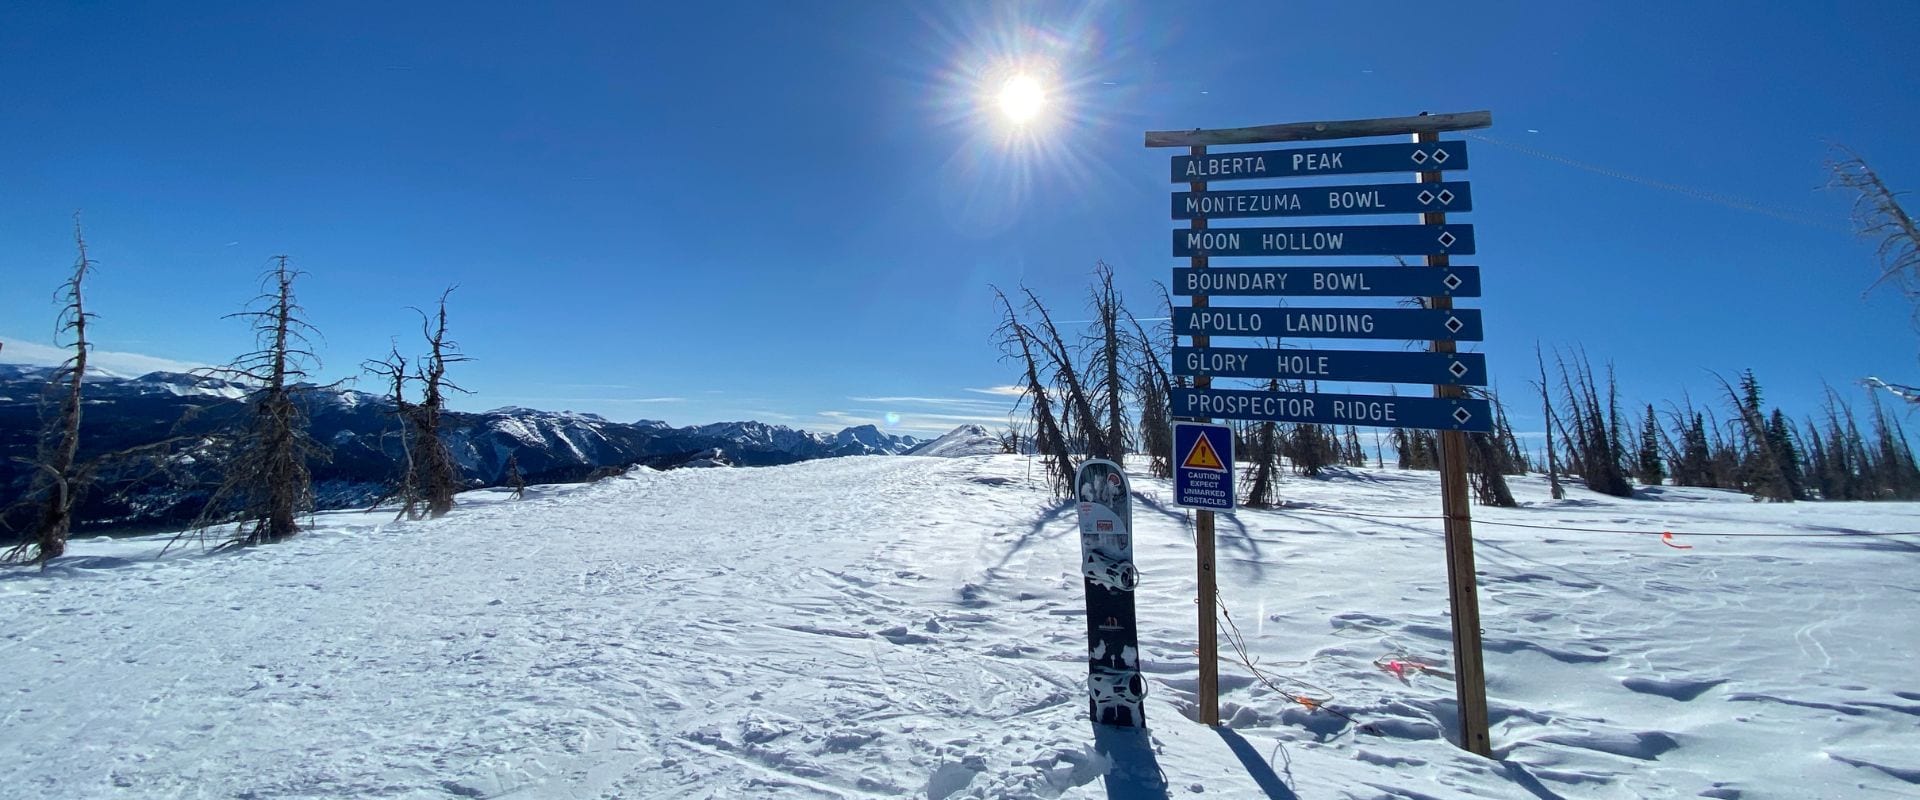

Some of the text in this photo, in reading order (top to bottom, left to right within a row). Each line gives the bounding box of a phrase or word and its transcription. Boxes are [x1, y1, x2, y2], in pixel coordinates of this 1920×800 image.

[1186, 152, 1343, 176] ALBERTA PEAK
[1186, 191, 1386, 213] MONTEZUMA BOWL
[1188, 232, 1344, 250] MOON HOLLOW
[1188, 272, 1371, 290] BOUNDARY BOWL
[1189, 312, 1374, 333] APOLLO LANDING
[1187, 353, 1329, 374] GLORY HOLE
[1188, 394, 1397, 421] PROSPECTOR RIDGE
[1188, 472, 1220, 480] CAUTION
[1184, 488, 1226, 497] UNMARKED
[1184, 496, 1226, 506] OBSTACLES
